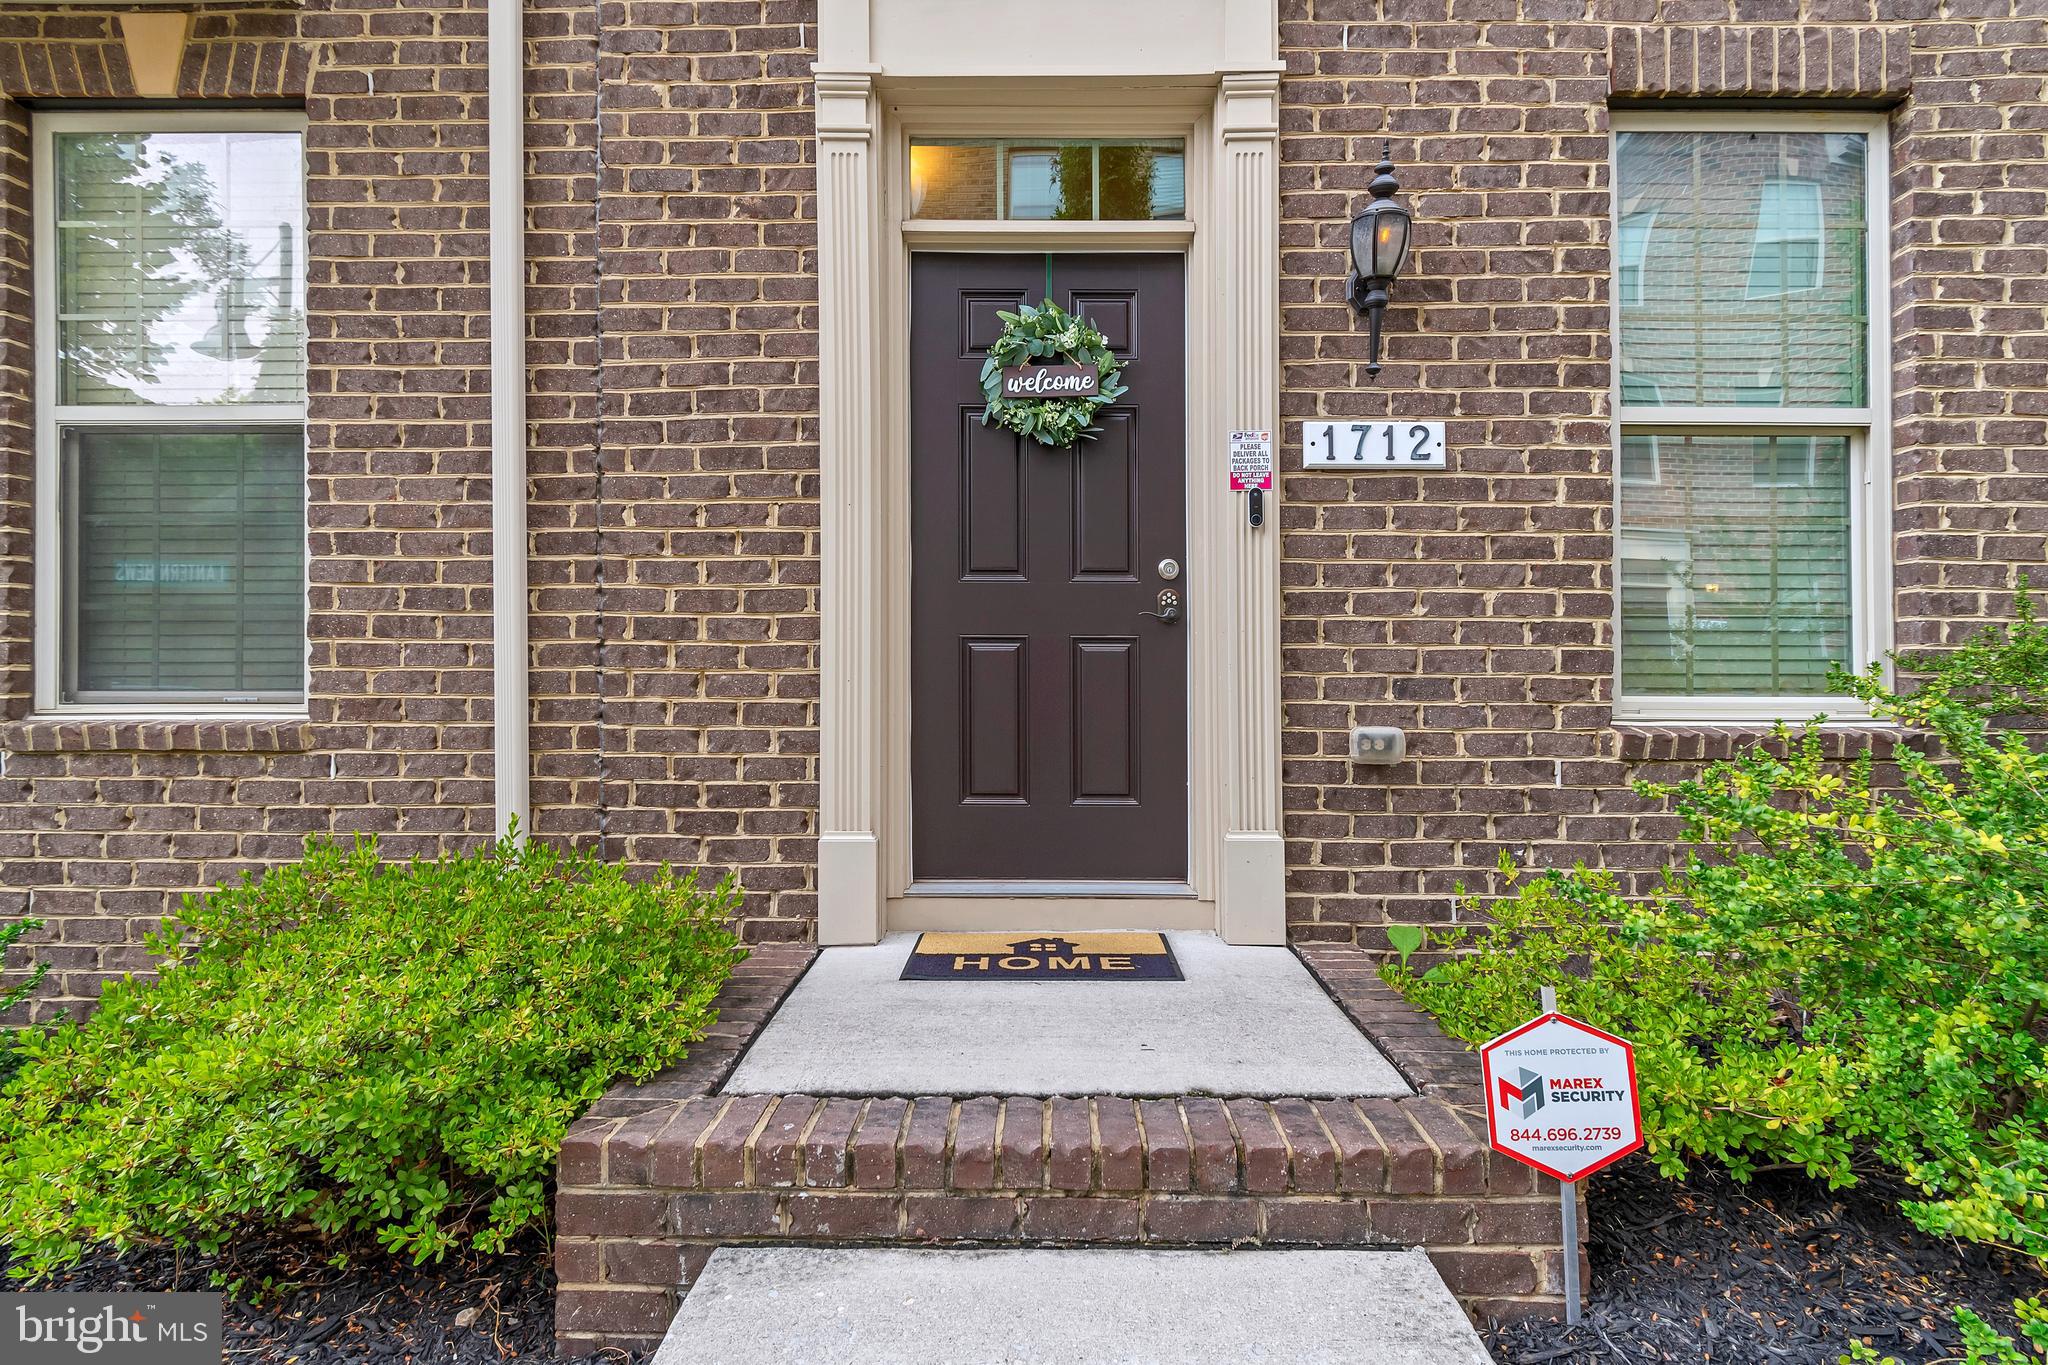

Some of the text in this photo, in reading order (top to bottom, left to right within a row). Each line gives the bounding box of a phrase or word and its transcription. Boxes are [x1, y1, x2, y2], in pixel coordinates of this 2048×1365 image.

[1007, 368, 1095, 394] welcome
[1322, 424, 1432, 461] 1712
[953, 955, 1137, 971] HOME
[1504, 1049, 1523, 1057] THIS
[1524, 1048, 1548, 1056] HOME
[1549, 1047, 1597, 1056] PROTECTED
[1549, 1077, 1604, 1090] MAREX
[1551, 1090, 1625, 1103] SECURITY
[1510, 1127, 1622, 1142] 844.696.2739
[1531, 1144, 1603, 1152] marexsecurity.com
